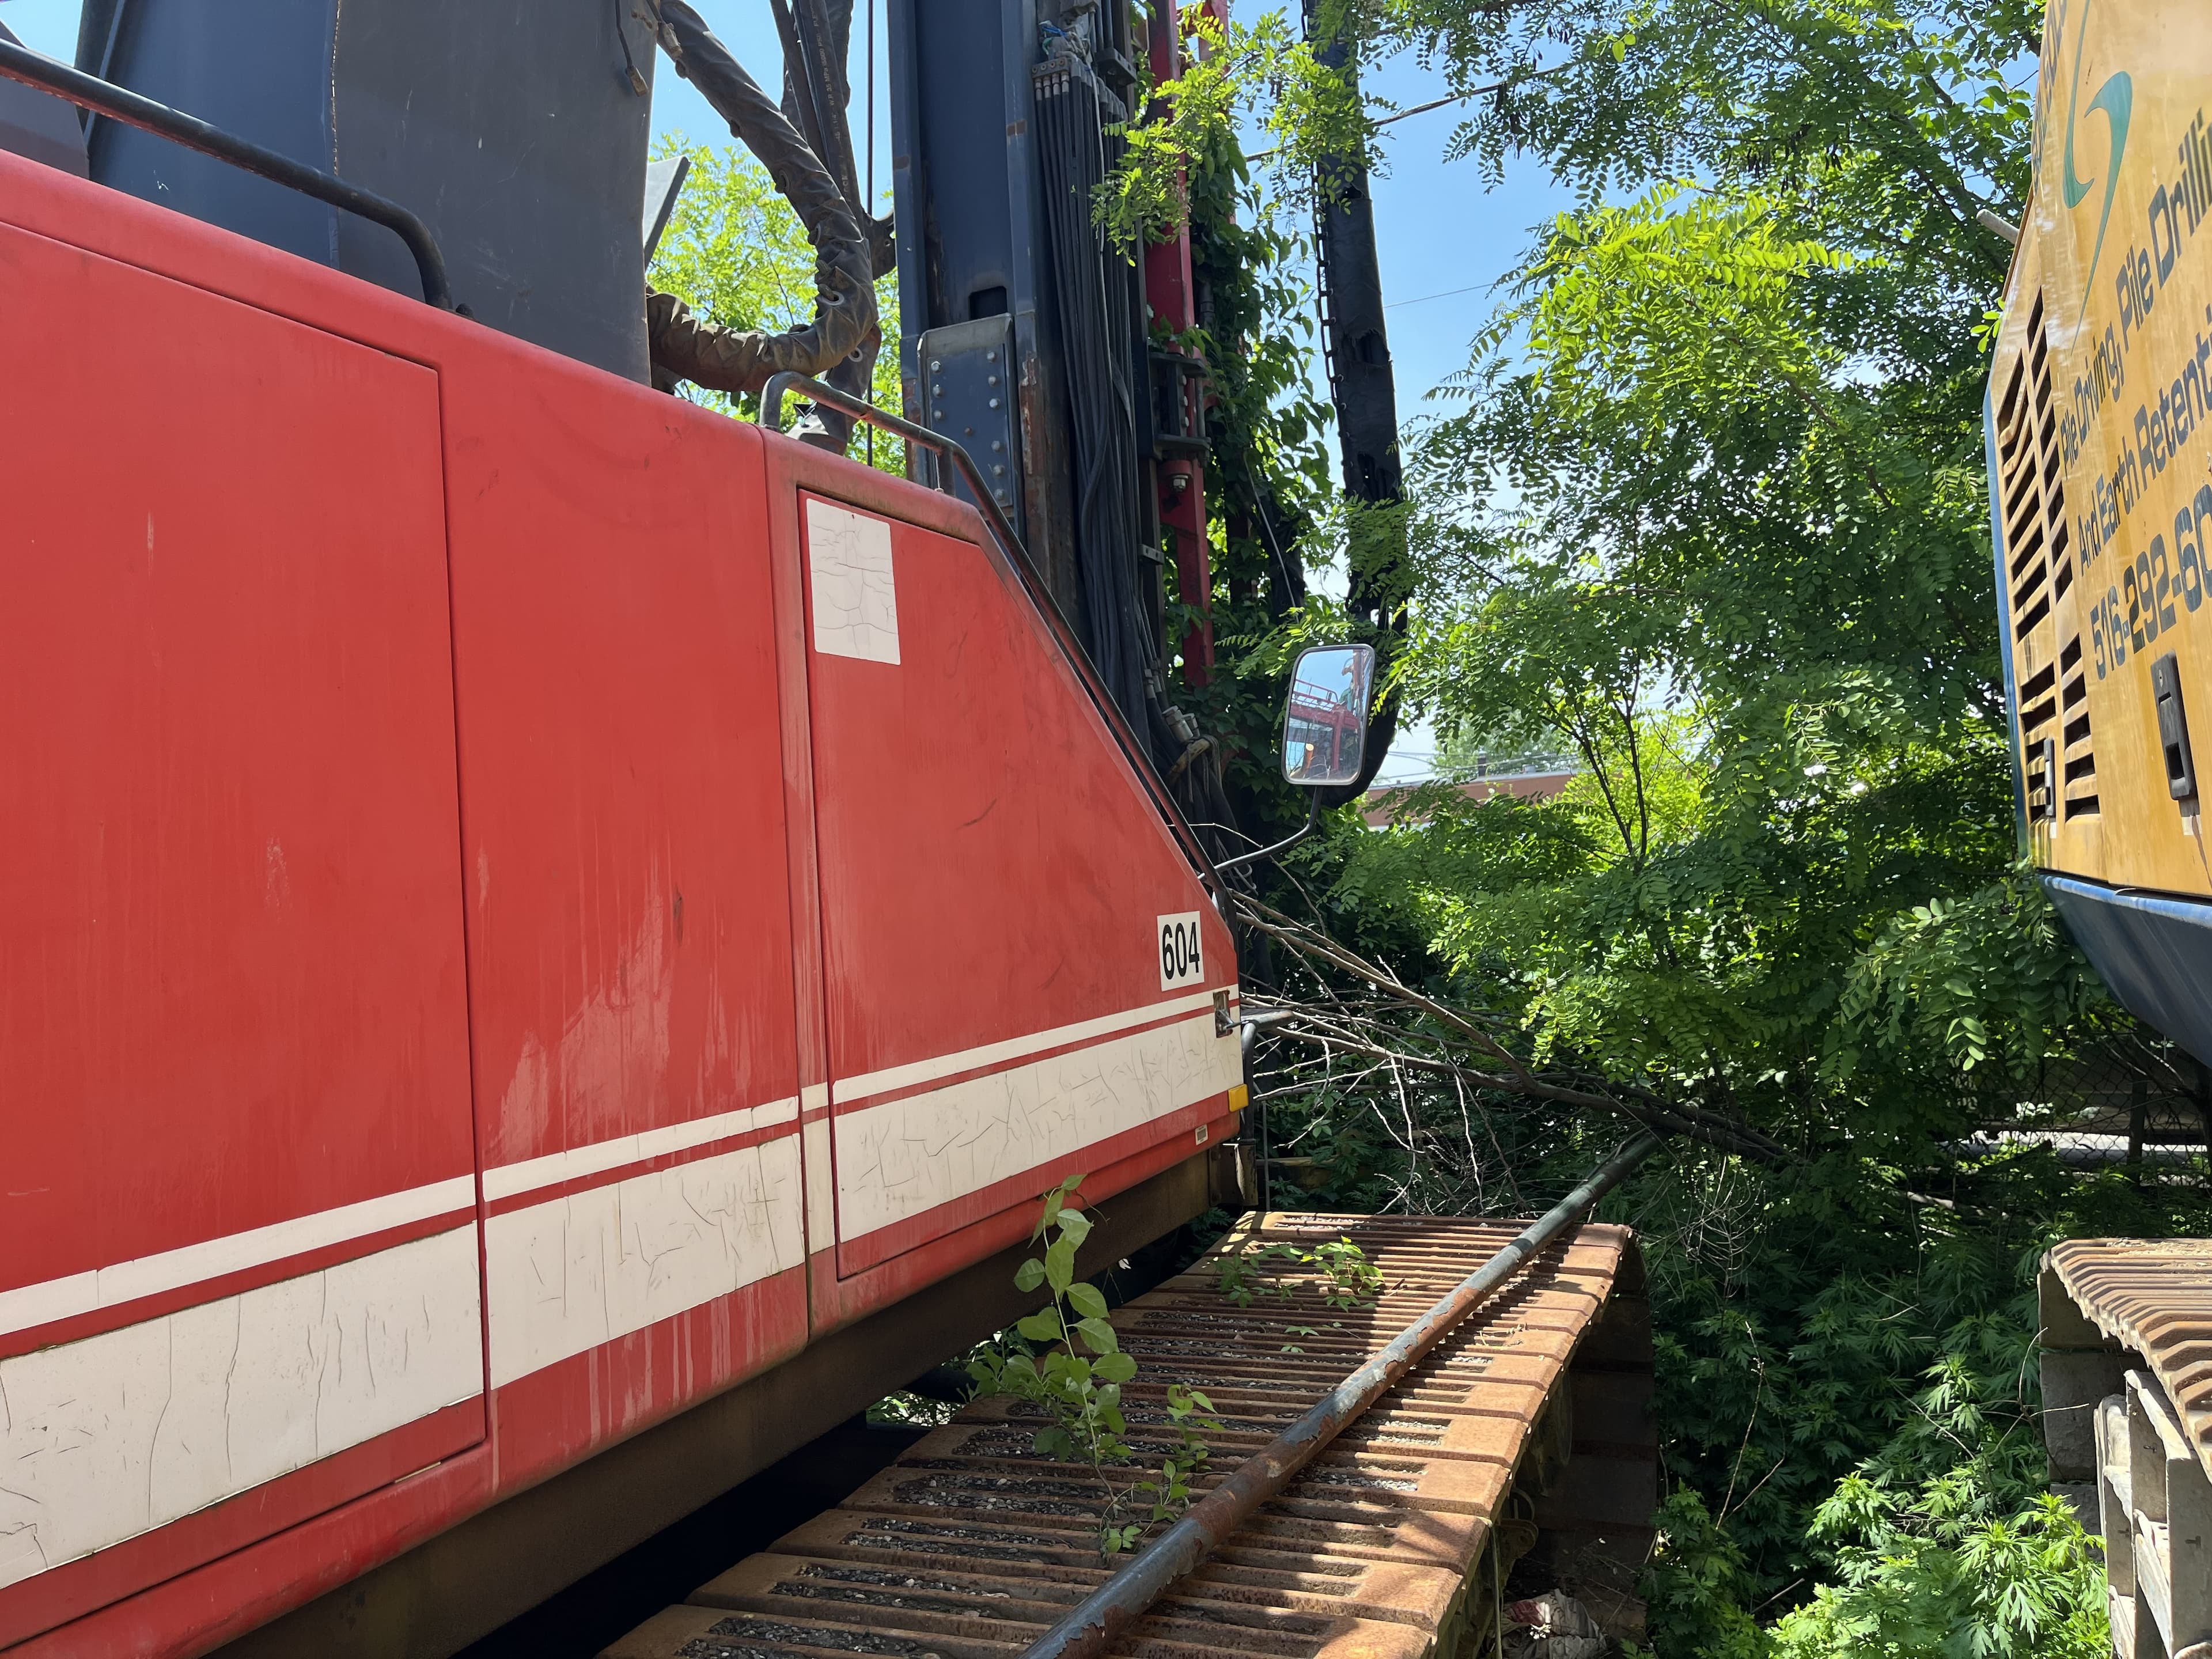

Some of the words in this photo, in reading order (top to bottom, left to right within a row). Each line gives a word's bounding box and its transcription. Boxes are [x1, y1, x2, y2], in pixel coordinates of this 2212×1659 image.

[2061, 407, 2079, 480] Pile
[2074, 321, 2125, 448] Driving,
[2116, 244, 2154, 354] Pile
[2078, 490, 2101, 577] And
[2096, 435, 2141, 546] Earth
[2090, 483, 2212, 681] 516-292-60
[1162, 922, 1200, 980] 604
